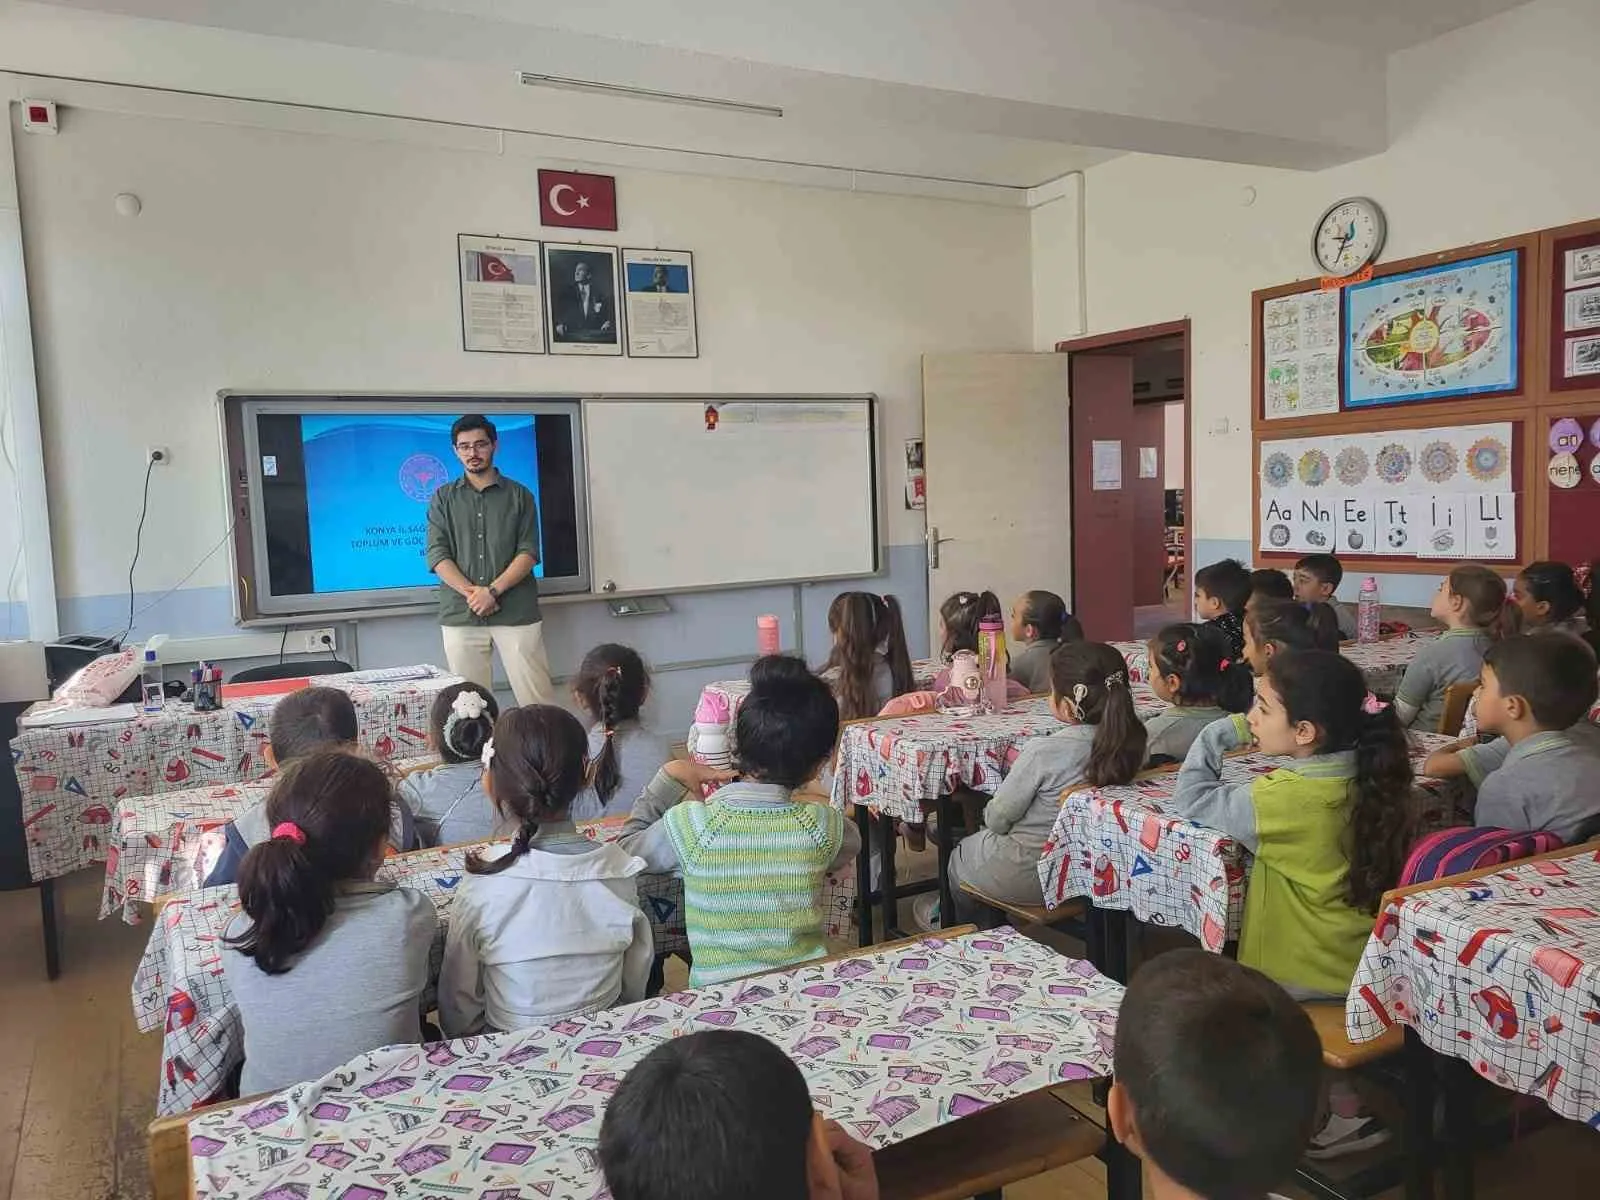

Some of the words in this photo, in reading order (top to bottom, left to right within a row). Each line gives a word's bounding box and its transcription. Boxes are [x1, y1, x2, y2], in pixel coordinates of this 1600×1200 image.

[1266, 499, 1292, 522] Aa
[1301, 499, 1330, 522] Nn
[1343, 499, 1367, 523] Ee
[1384, 500, 1408, 525] Tt
[1479, 494, 1503, 522] Ll
[366, 526, 397, 535] KONYA
[408, 521, 425, 533] SAĞ
[351, 539, 390, 548] TOPLUM
[392, 538, 403, 547] VE
